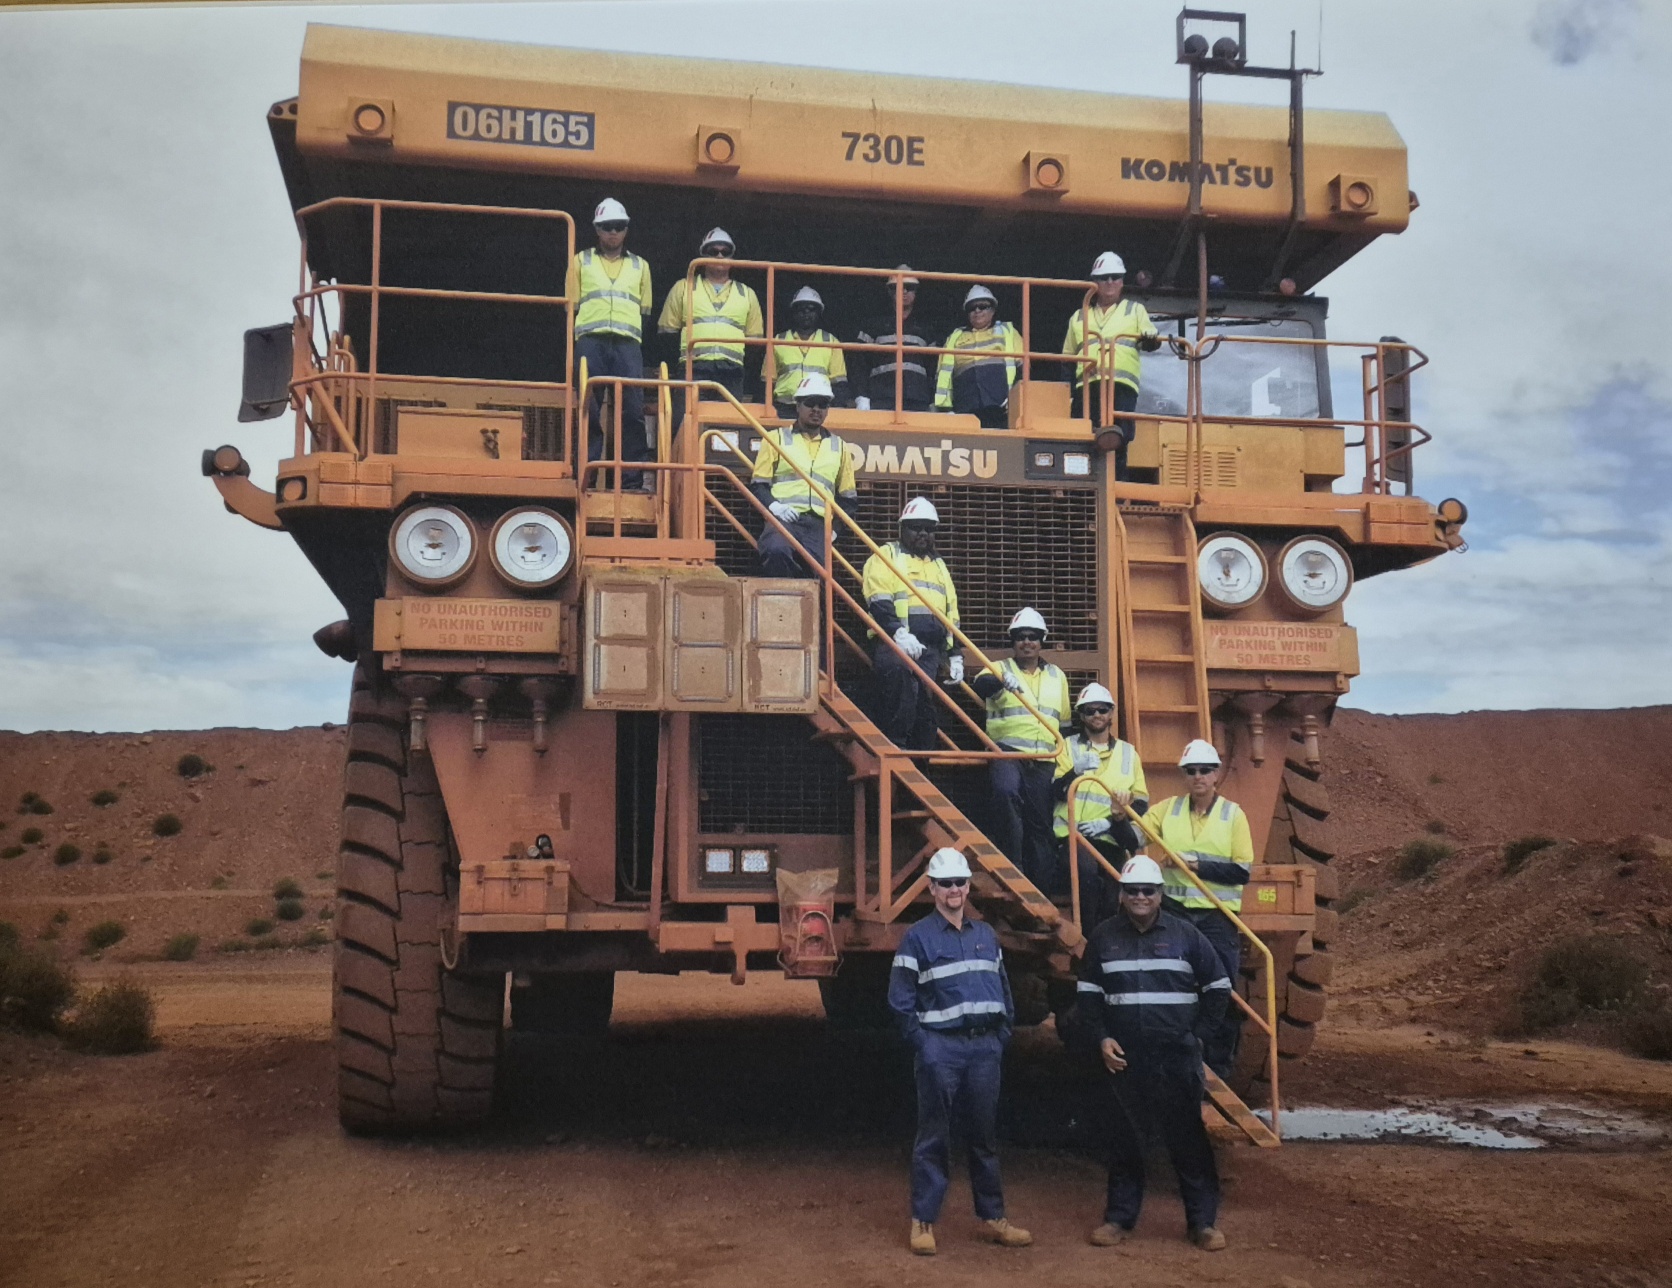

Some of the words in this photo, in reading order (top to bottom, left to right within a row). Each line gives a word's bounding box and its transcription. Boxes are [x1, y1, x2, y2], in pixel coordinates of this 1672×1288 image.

[453, 105, 589, 146] 06H165
[841, 131, 925, 167] 730E
[1121, 157, 1274, 189] KOMATSU
[846, 439, 998, 478] OMATSU
[410, 602, 431, 615] NO
[437, 603, 552, 619] UNAUTHORISED
[420, 617, 485, 631] PARKING
[491, 620, 543, 633] WITHIN
[1210, 625, 1229, 636] NO
[1234, 625, 1333, 639] UNAUTHORISED
[439, 633, 457, 645] 50
[463, 634, 524, 648] METRES
[1220, 638, 1276, 651] PARKING
[1281, 640, 1327, 653] WITHIN
[1237, 652, 1253, 664] 50
[1258, 653, 1311, 666] METRES
